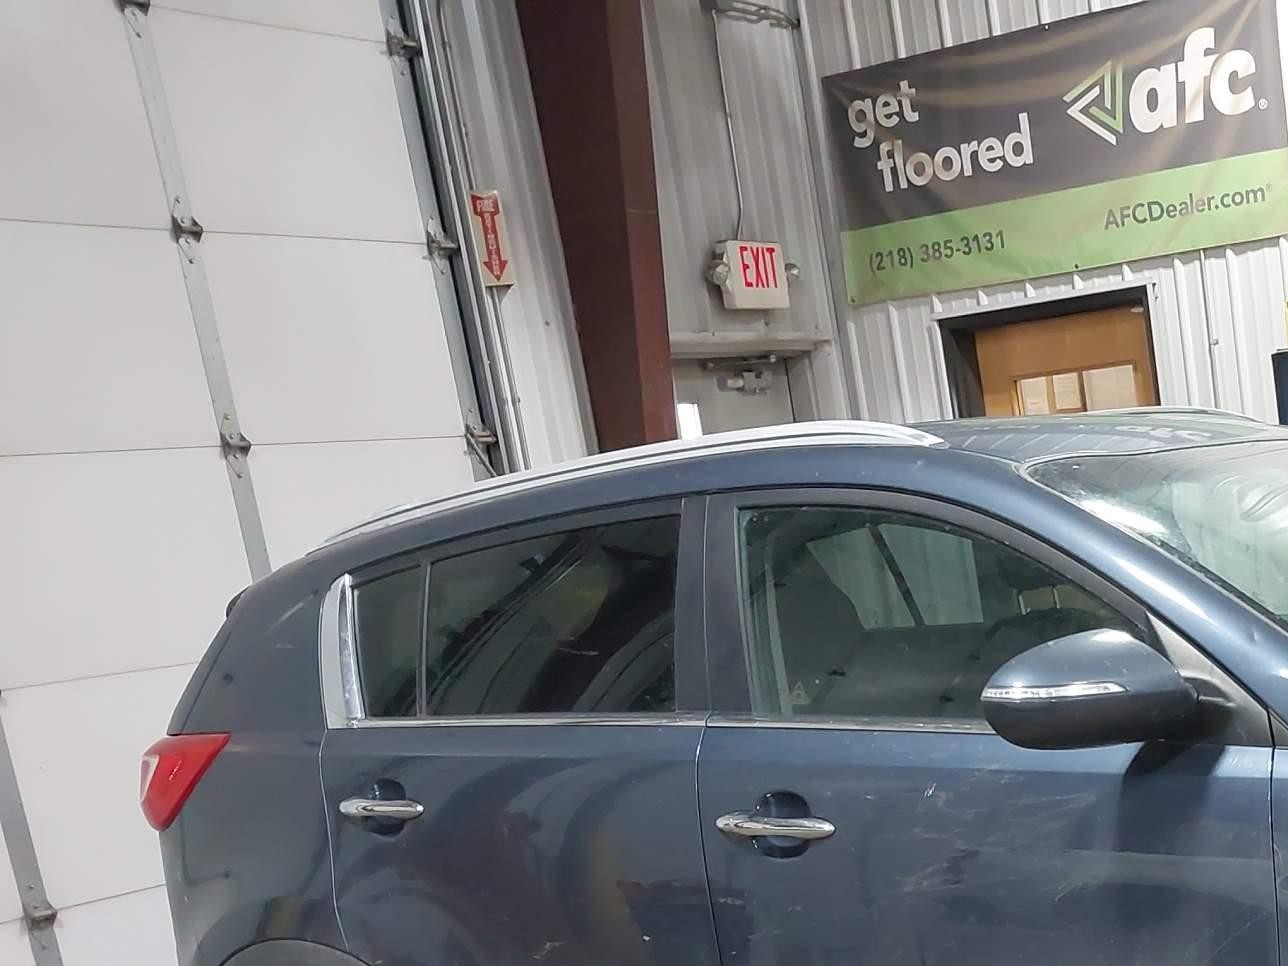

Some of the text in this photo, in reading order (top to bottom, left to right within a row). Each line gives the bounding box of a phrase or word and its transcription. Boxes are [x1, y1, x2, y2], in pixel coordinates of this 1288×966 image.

[848, 80, 921, 148] get
[877, 112, 1034, 193] floored
[740, 246, 778, 288] EXIT
[869, 230, 1006, 276] (218) 385-3131
